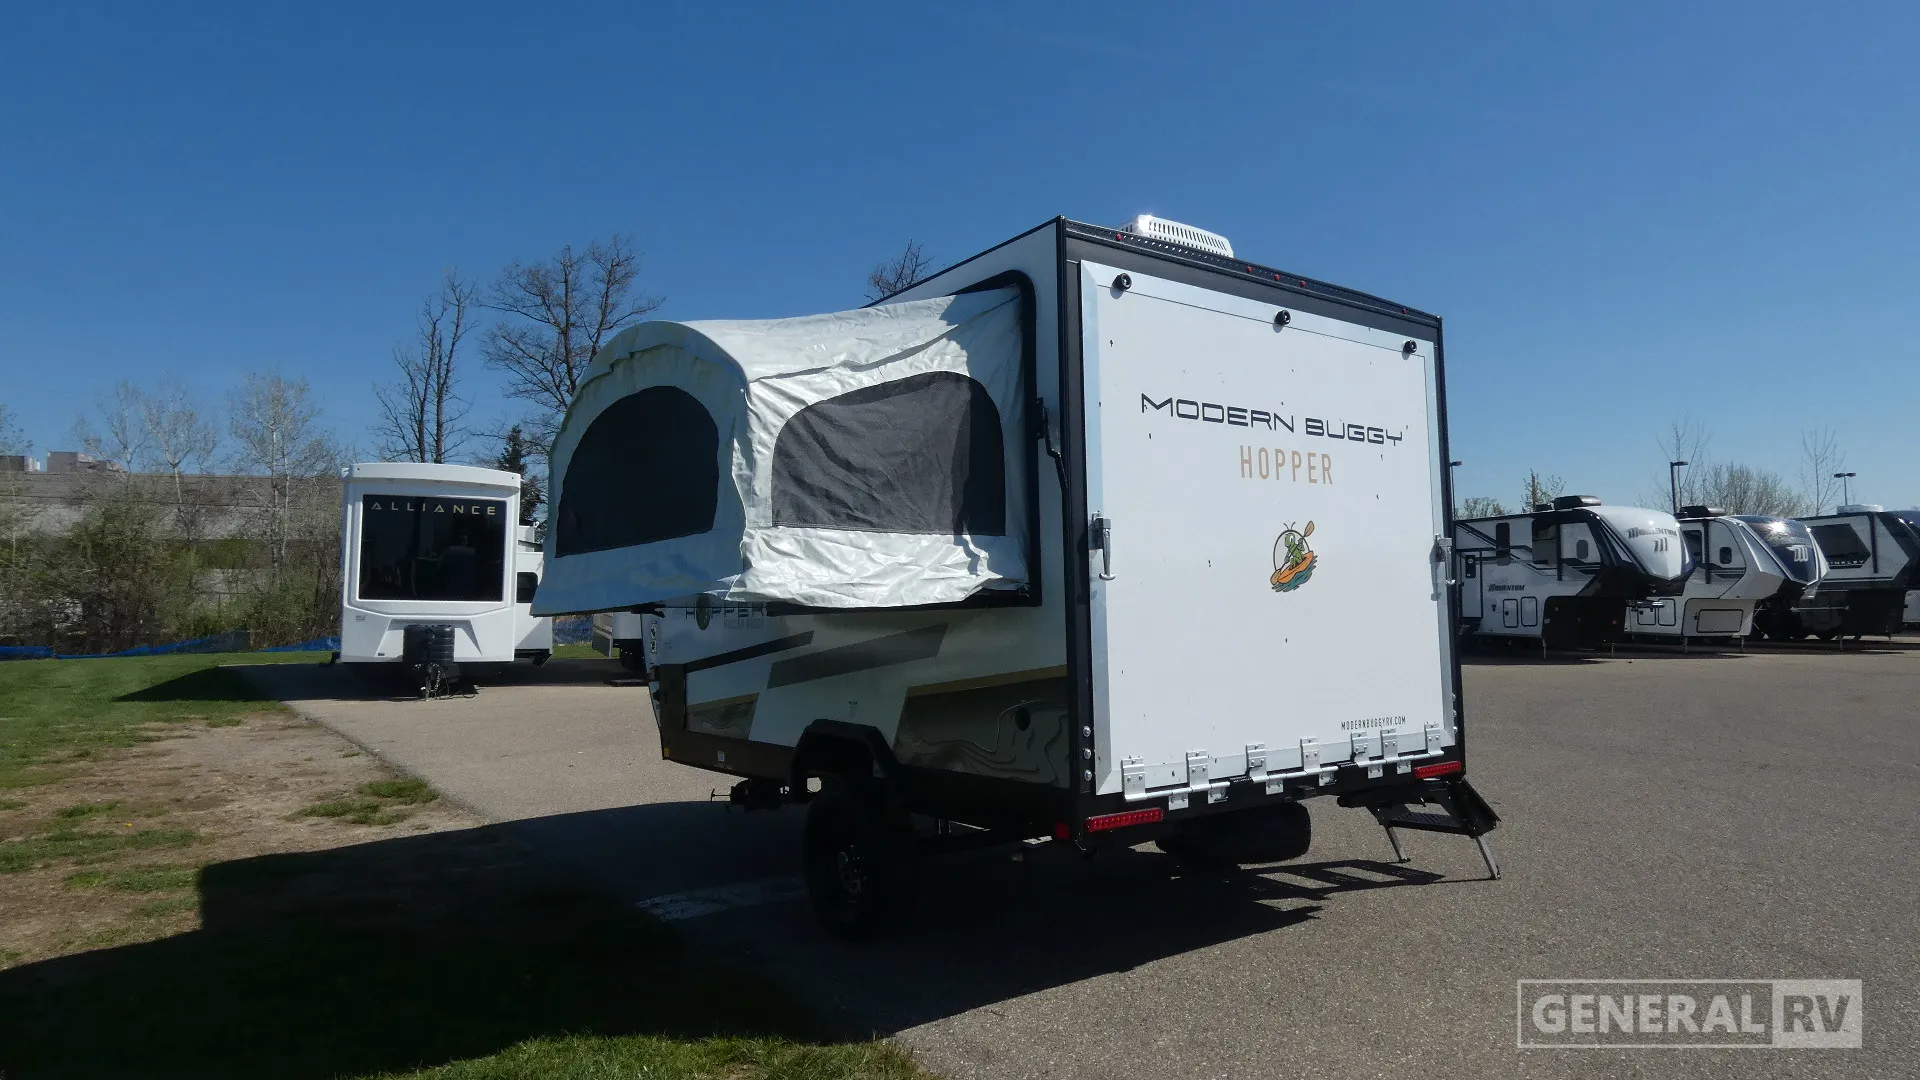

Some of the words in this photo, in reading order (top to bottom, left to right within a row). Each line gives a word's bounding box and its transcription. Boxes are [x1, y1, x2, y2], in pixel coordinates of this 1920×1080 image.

[1141, 393, 1295, 433] MODERN
[1305, 417, 1402, 446] BUGGY
[1240, 445, 1333, 484] HOPPER
[371, 501, 496, 515] ALLIANCE
